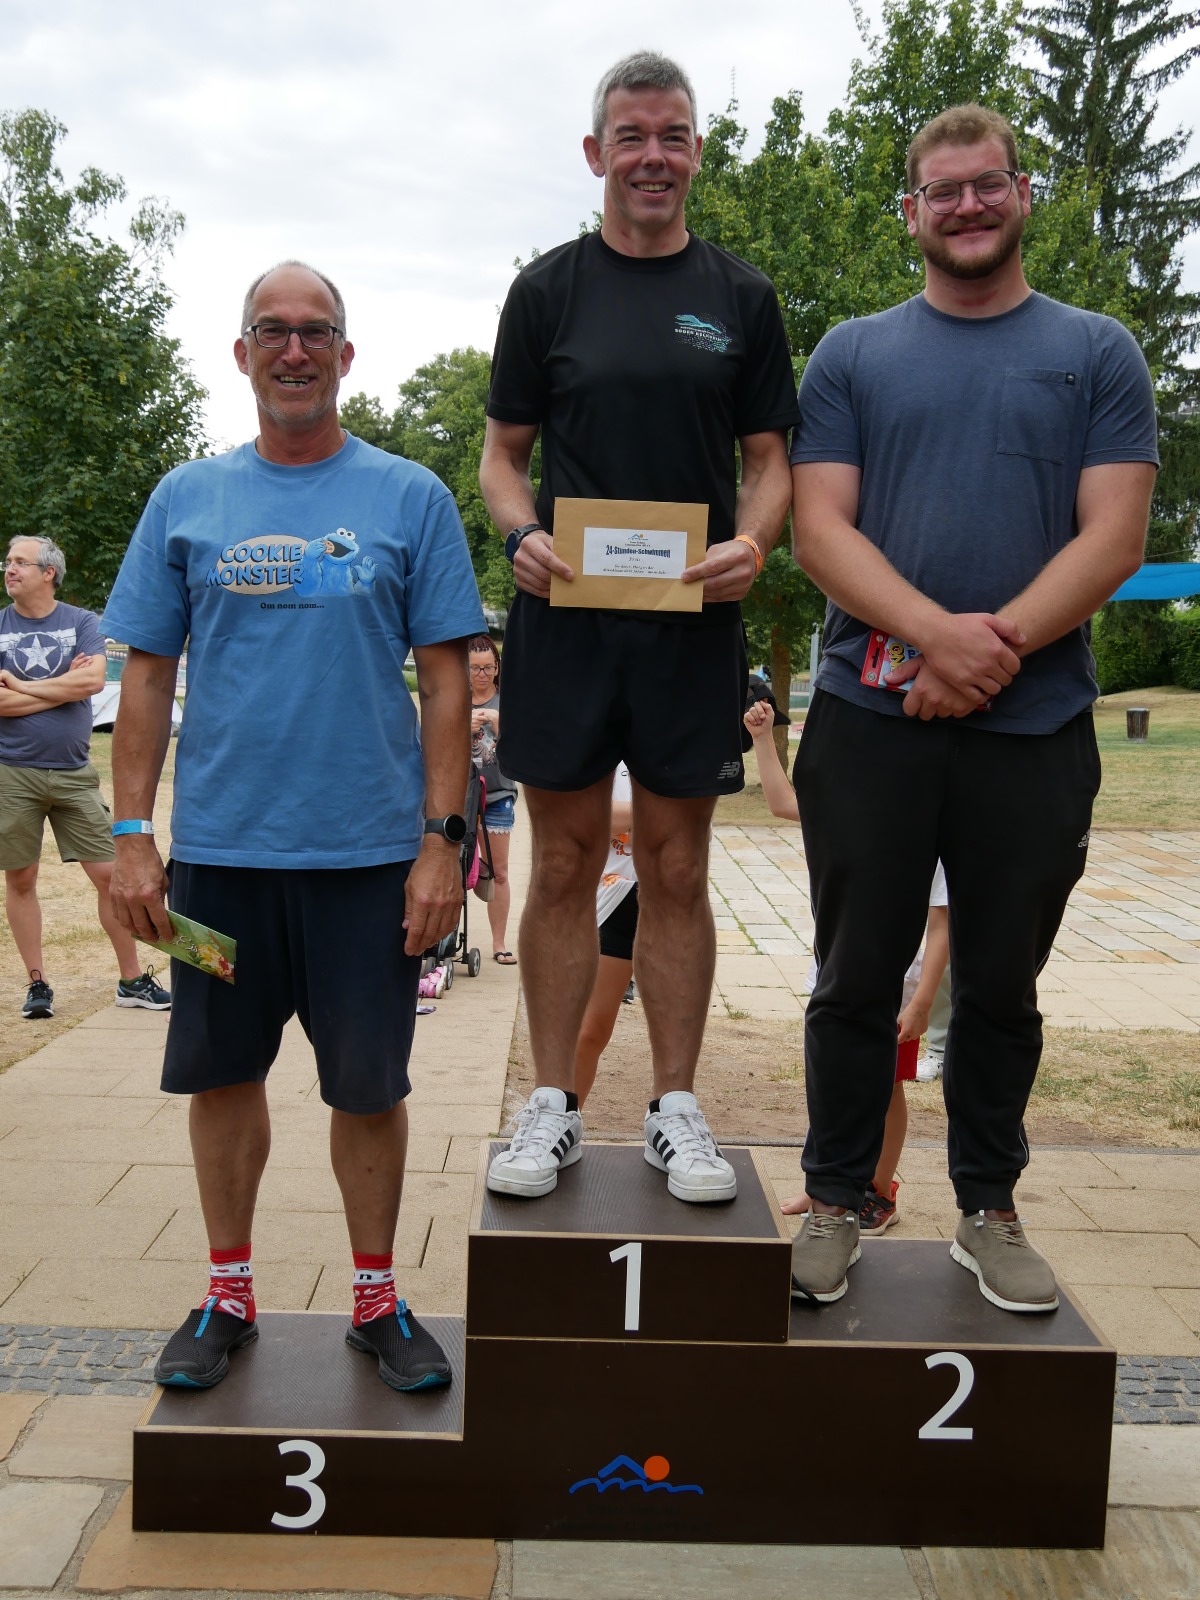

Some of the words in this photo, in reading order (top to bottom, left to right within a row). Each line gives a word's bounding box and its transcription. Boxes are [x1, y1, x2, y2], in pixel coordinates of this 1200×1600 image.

[220, 543, 303, 563] COOKIE
[605, 544, 671, 558] 24-Stunden-Schwimmen
[205, 564, 304, 587] MONSTER
[260, 602, 276, 610] Om
[609, 1242, 642, 1331] 1
[918, 1351, 975, 1440] 2
[270, 1439, 326, 1529] 3
